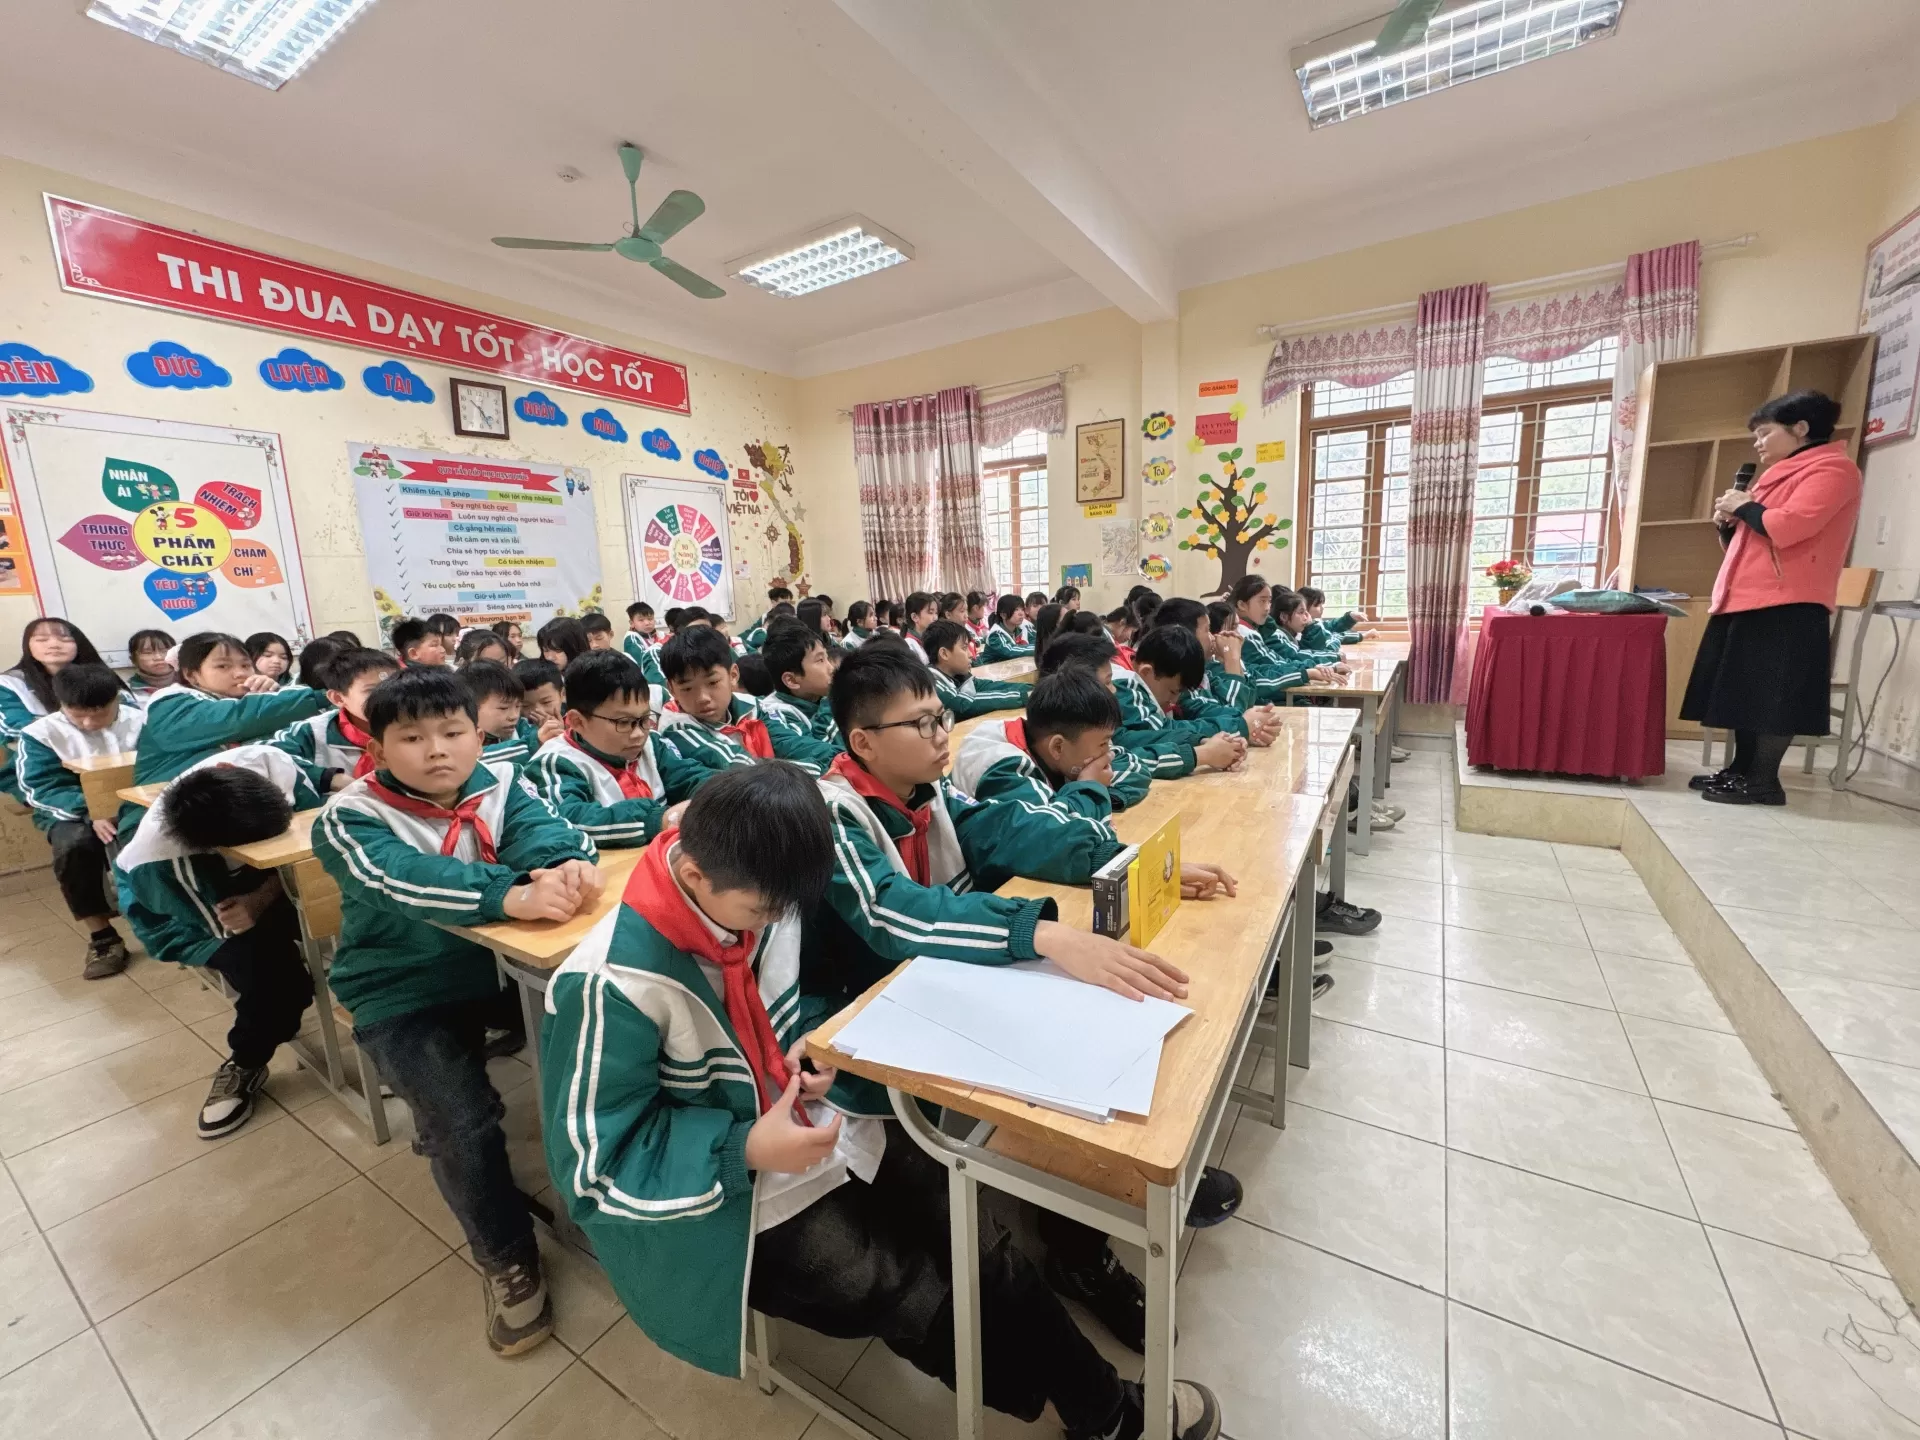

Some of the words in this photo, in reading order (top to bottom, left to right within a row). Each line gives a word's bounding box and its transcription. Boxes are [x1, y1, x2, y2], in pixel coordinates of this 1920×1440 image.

[157, 252, 243, 302] THI
[259, 277, 356, 328] ĐUA
[367, 304, 444, 348] DẠY
[455, 324, 514, 361] TỐT
[541, 346, 604, 383] HỌC
[611, 361, 653, 393] TỐT
[0, 355, 59, 385] RÈN
[153, 355, 202, 378] ĐỨC
[268, 362, 330, 388] LUYỆN
[383, 371, 412, 395] TÀI
[523, 400, 555, 420] NGÀY
[593, 417, 616, 435] MAI
[652, 435, 672, 452] LẬP
[108, 468, 148, 482] NHÂN
[402, 486, 427, 495] Khiêm
[452, 490, 470, 498] phép
[733, 489, 750, 502] TÔI
[451, 501, 464, 510] Suy
[482, 502, 495, 510] tích
[496, 504, 509, 512] cực
[173, 507, 198, 529] 5
[405, 509, 421, 518] Giữ
[434, 511, 449, 519] hứa
[81, 524, 128, 535] TRUNG
[152, 533, 216, 549] PHẨM
[448, 535, 463, 543] Biết
[446, 547, 463, 555] Chia
[474, 548, 488, 556] hợp
[161, 551, 215, 567] CHẤT
[429, 559, 451, 567] Trung
[451, 559, 469, 567] thực
[484, 569, 497, 577] học
[153, 577, 179, 591] YÊU
[438, 582, 456, 590] cuộc
[457, 581, 476, 590] sống
[160, 596, 197, 610] NƯỚC
[441, 605, 456, 613] mỗi
[487, 603, 506, 611] Siêng
